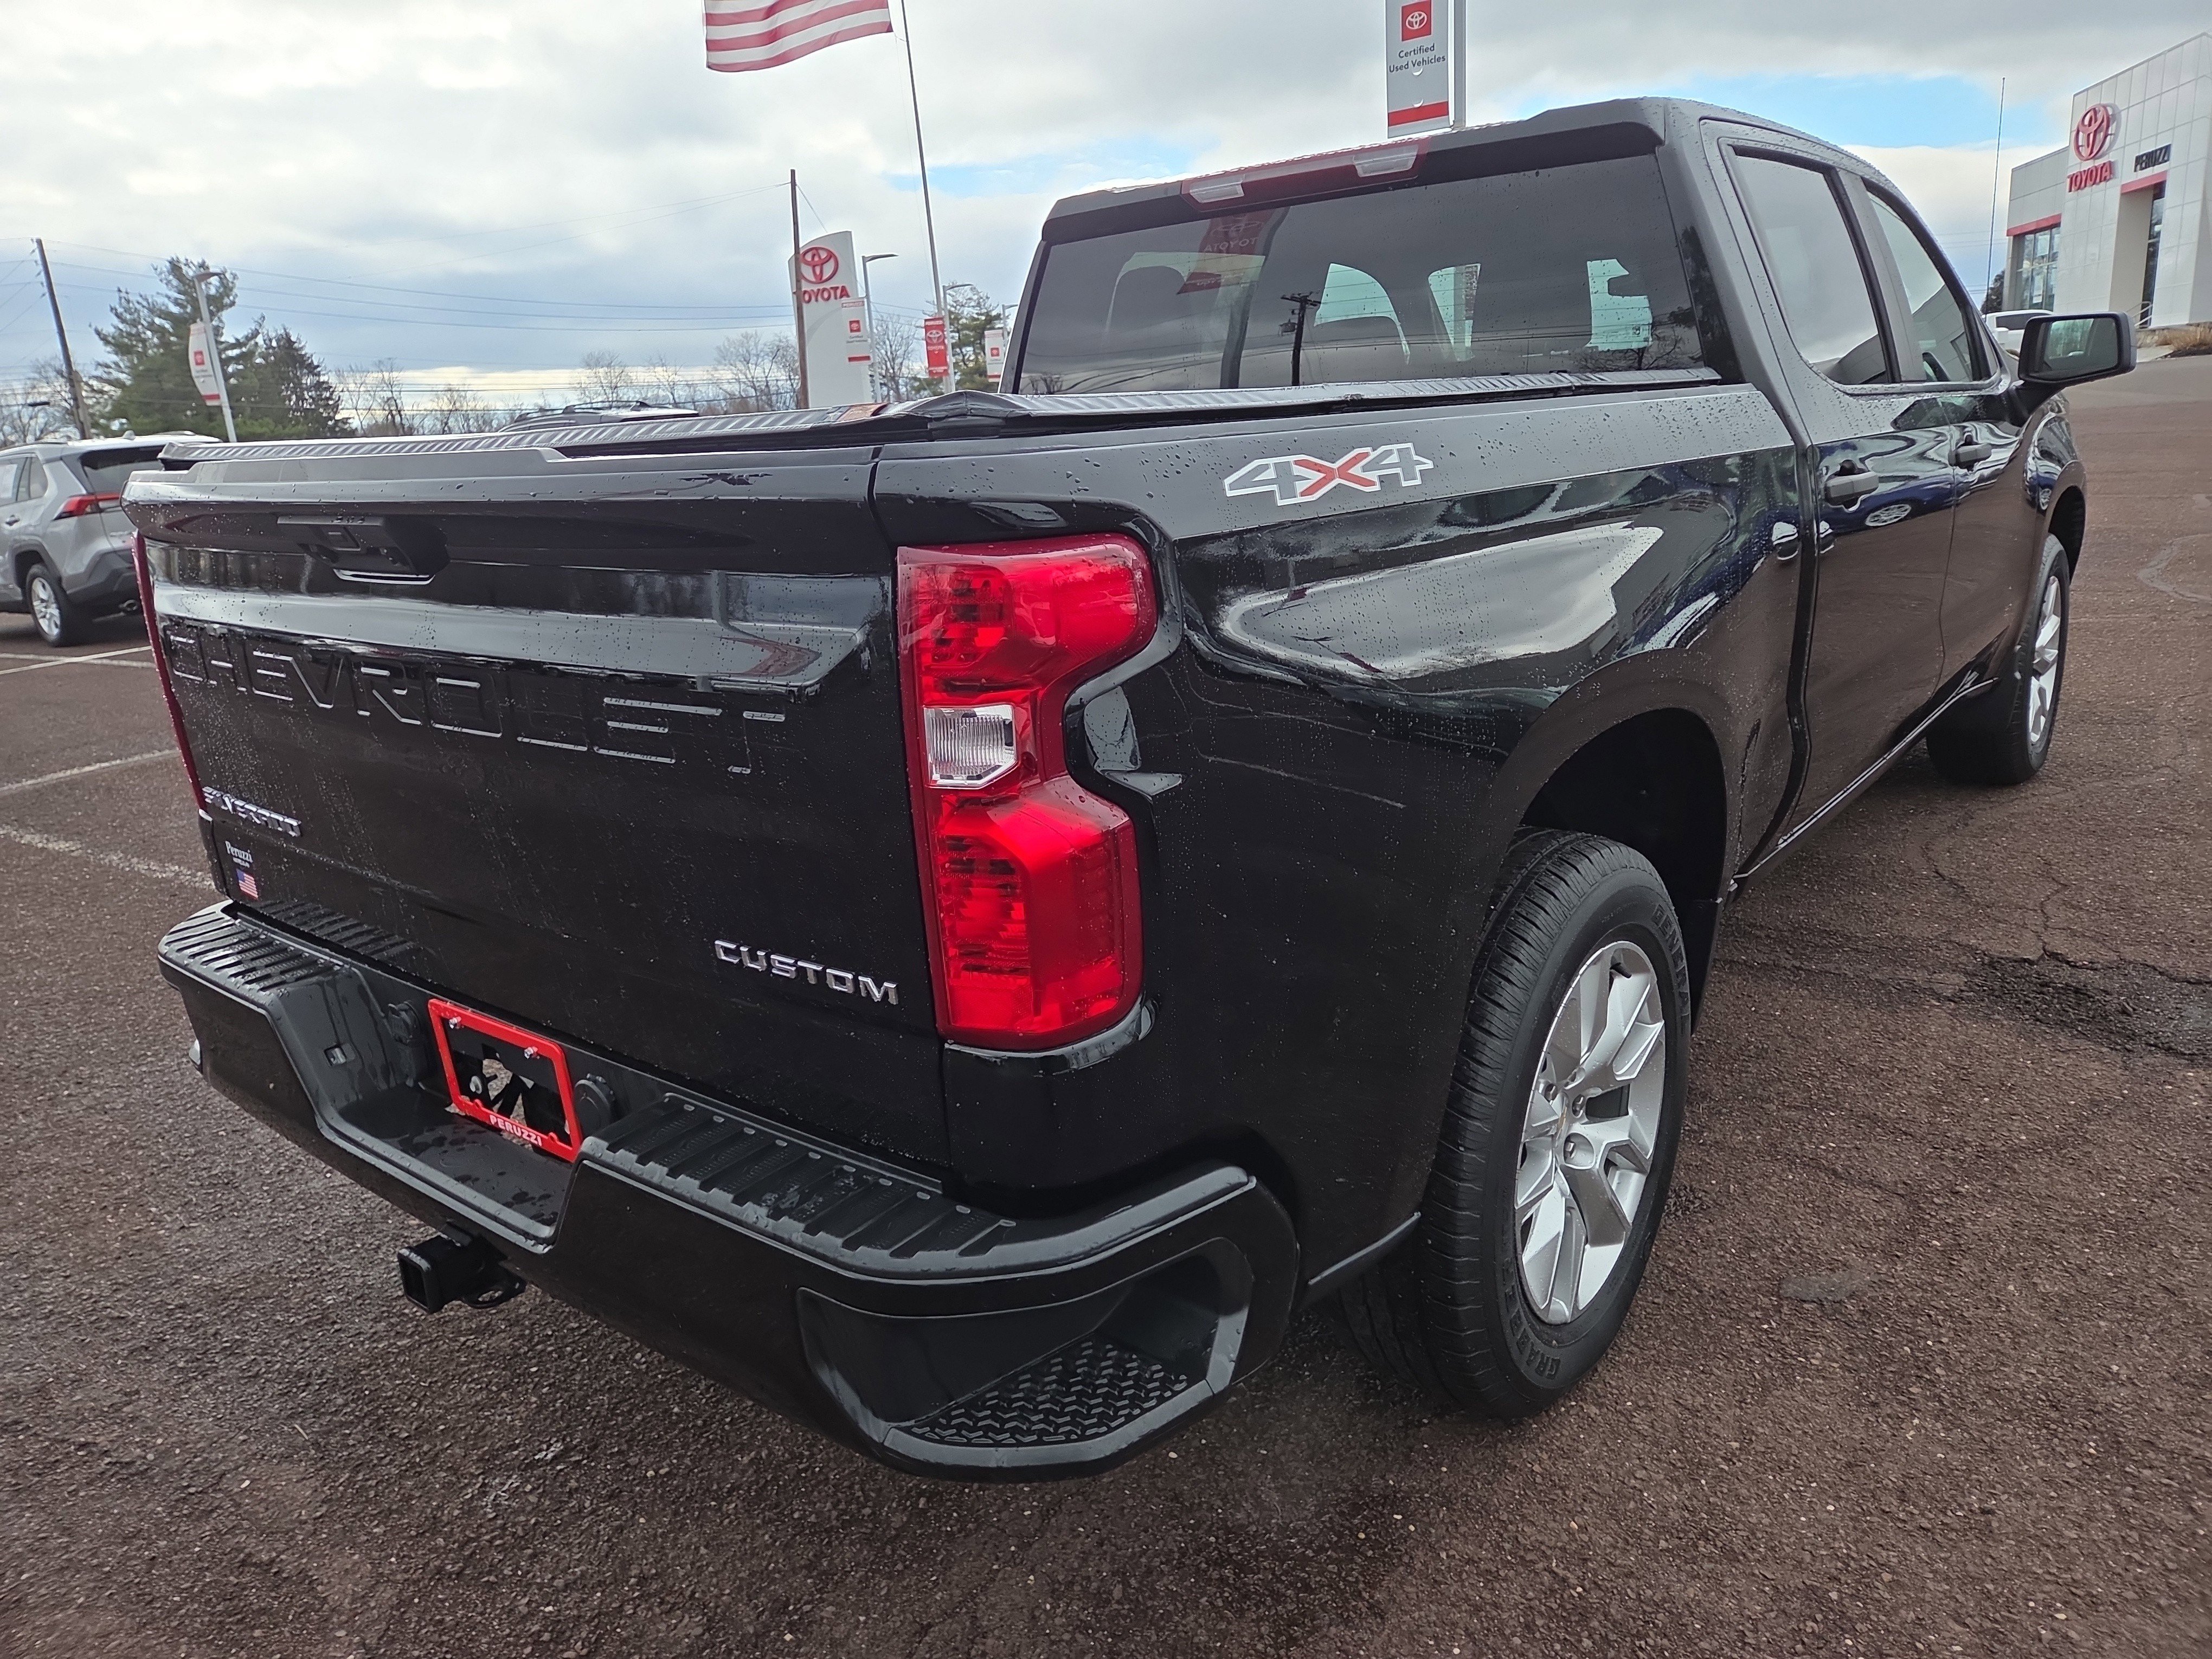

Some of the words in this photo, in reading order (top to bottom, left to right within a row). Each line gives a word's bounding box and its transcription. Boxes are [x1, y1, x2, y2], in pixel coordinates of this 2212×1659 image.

[1398, 42, 1435, 58] Certified
[1389, 61, 1409, 73] Used
[1411, 55, 1446, 68] Vehicles
[2067, 160, 2113, 192] TOYOTA
[793, 285, 850, 304] OYOTA
[166, 632, 786, 774] CHEVROLET
[225, 840, 253, 863] Peruzzi
[714, 940, 899, 1005] CUSTOM
[490, 1114, 542, 1147] PERUZZI
